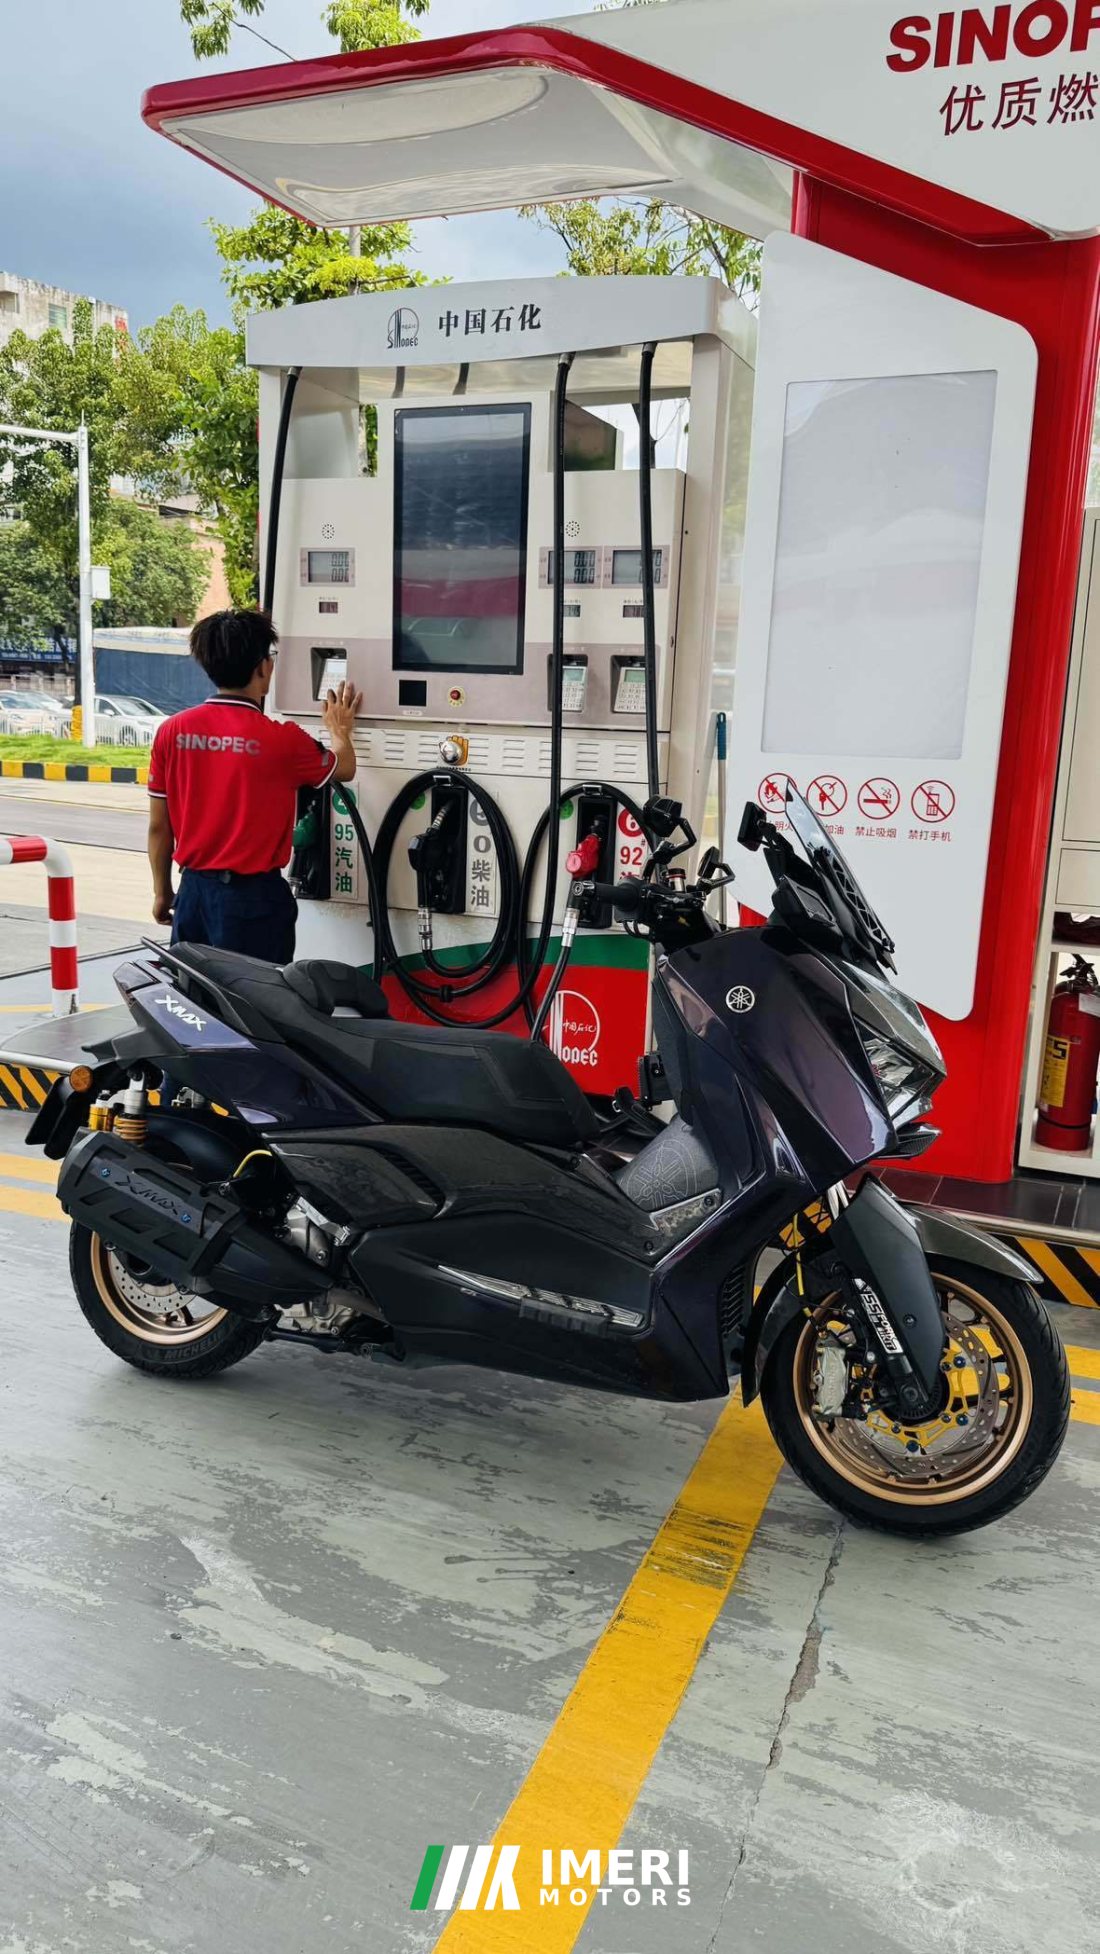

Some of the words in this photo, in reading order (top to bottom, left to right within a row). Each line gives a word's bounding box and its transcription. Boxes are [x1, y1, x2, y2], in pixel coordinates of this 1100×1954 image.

[938, 71, 1100, 136] 优质燃
[438, 303, 542, 337] 中国石化
[176, 733, 261, 756] SINOPEC
[335, 823, 354, 841] 95
[855, 825, 897, 839] 禁止吸烟
[908, 828, 952, 843] 禁打手机
[335, 846, 354, 893] 汽油
[470, 859, 491, 908] 柴油
[154, 994, 207, 1031] XMAX
